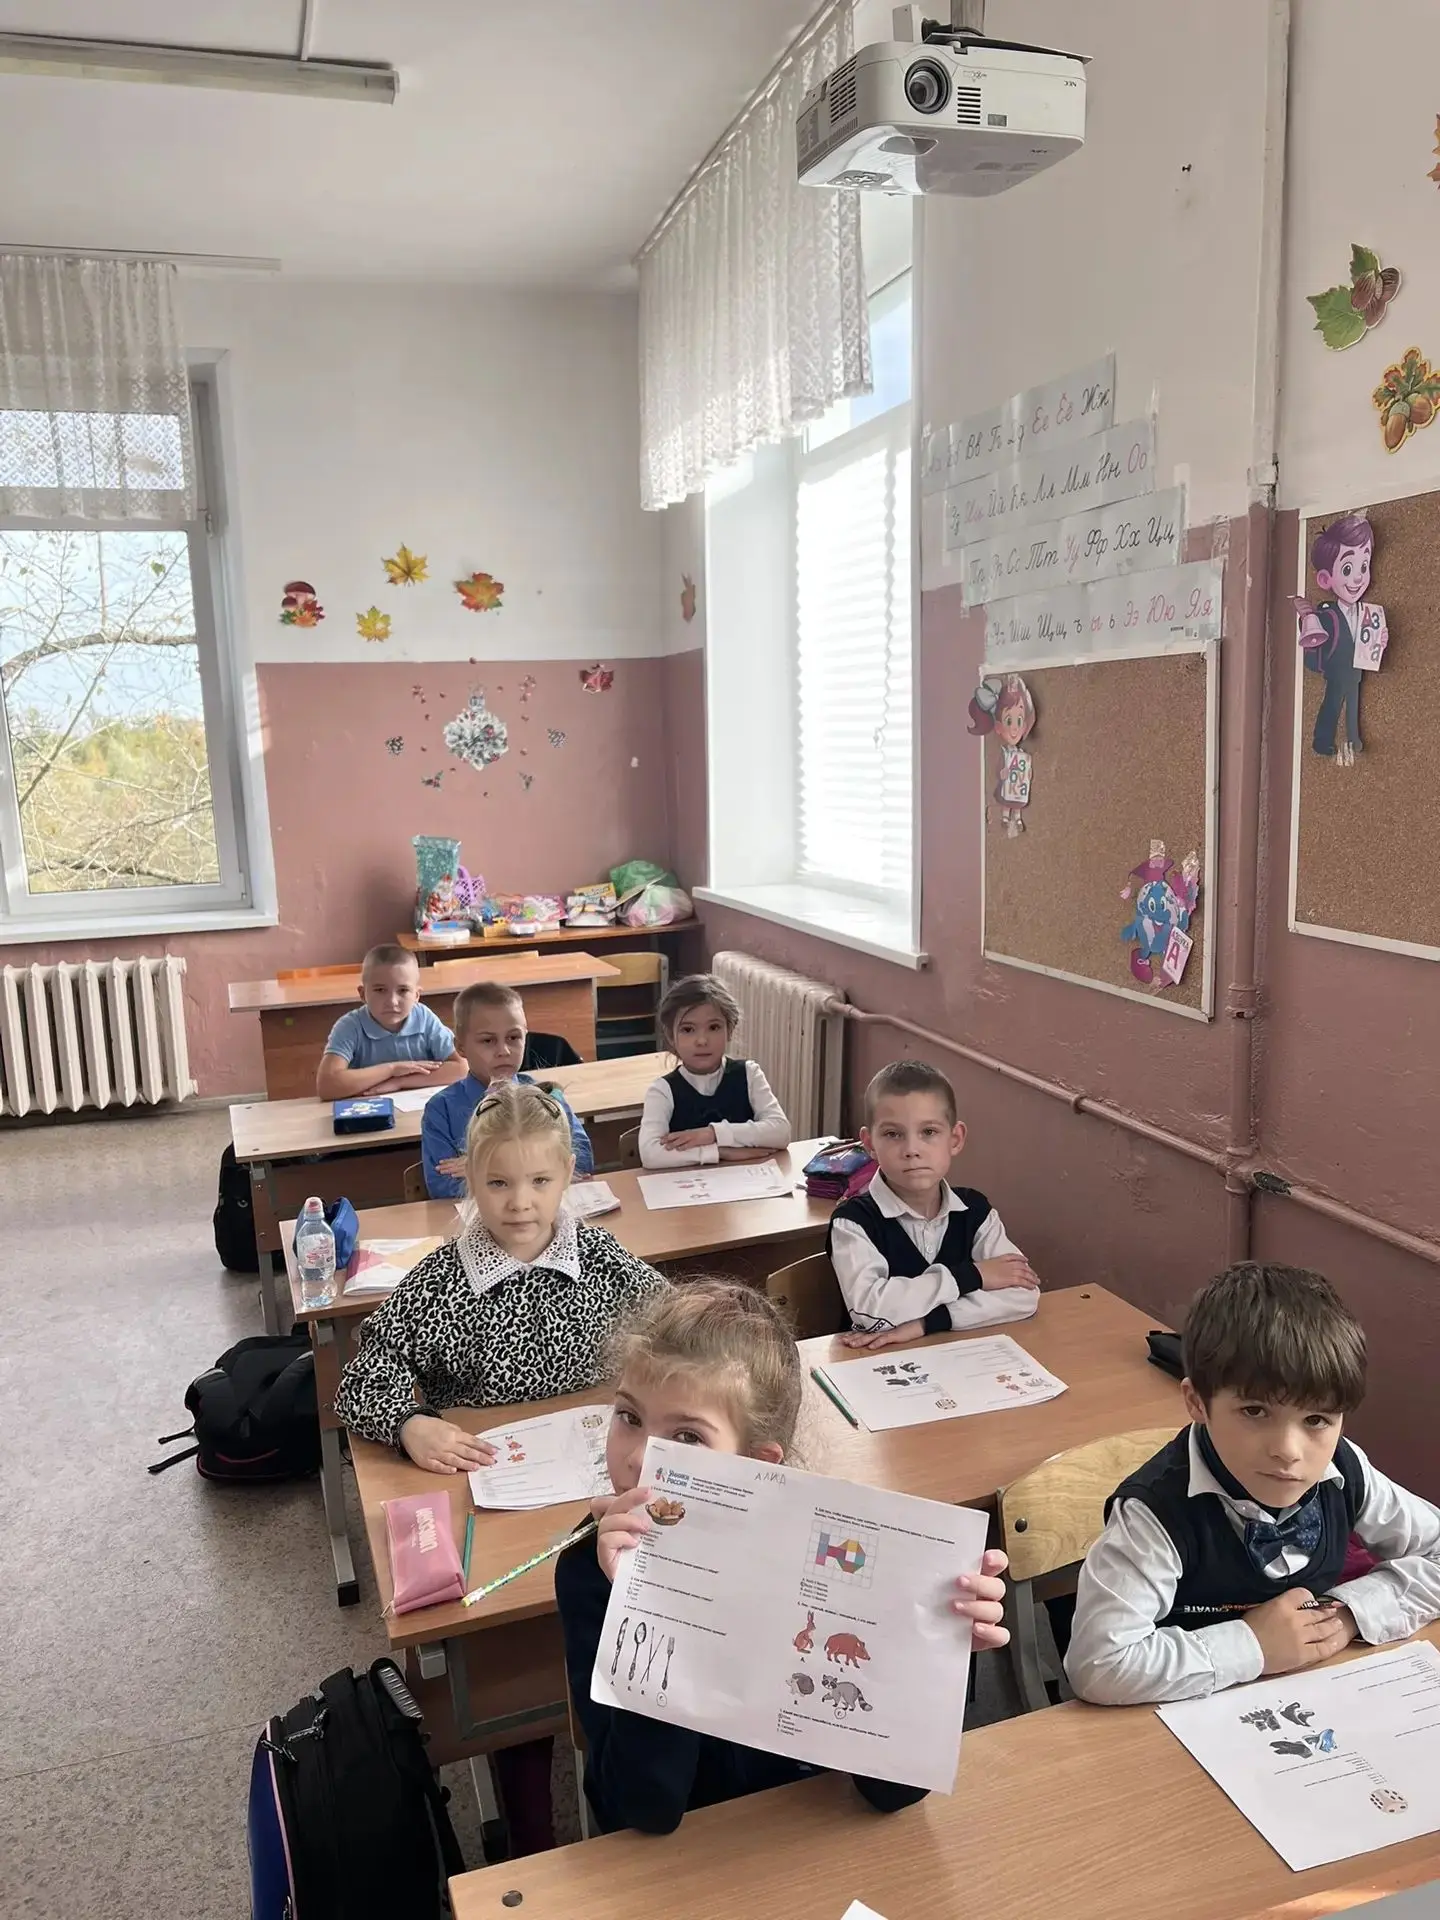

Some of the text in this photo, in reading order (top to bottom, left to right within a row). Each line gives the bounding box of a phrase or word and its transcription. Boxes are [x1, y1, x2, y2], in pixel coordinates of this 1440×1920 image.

[965, 432, 982, 460] Вв
[1032, 406, 1048, 434] Ее
[1081, 384, 1110, 416] Жж
[1033, 473, 1055, 503] Лл
[1061, 465, 1090, 494] Мм
[1096, 452, 1121, 484] Нн
[1128, 443, 1147, 474] Оо
[1025, 541, 1059, 570] Тт
[1084, 529, 1108, 567] Фф
[1113, 523, 1141, 551] Хх
[1148, 516, 1175, 547] Цц
[1009, 620, 1030, 643] Шш
[1037, 612, 1067, 642] Щщ
[1123, 601, 1139, 628] Ээ
[1146, 594, 1176, 624] Юю
[1184, 588, 1214, 619] Яя
